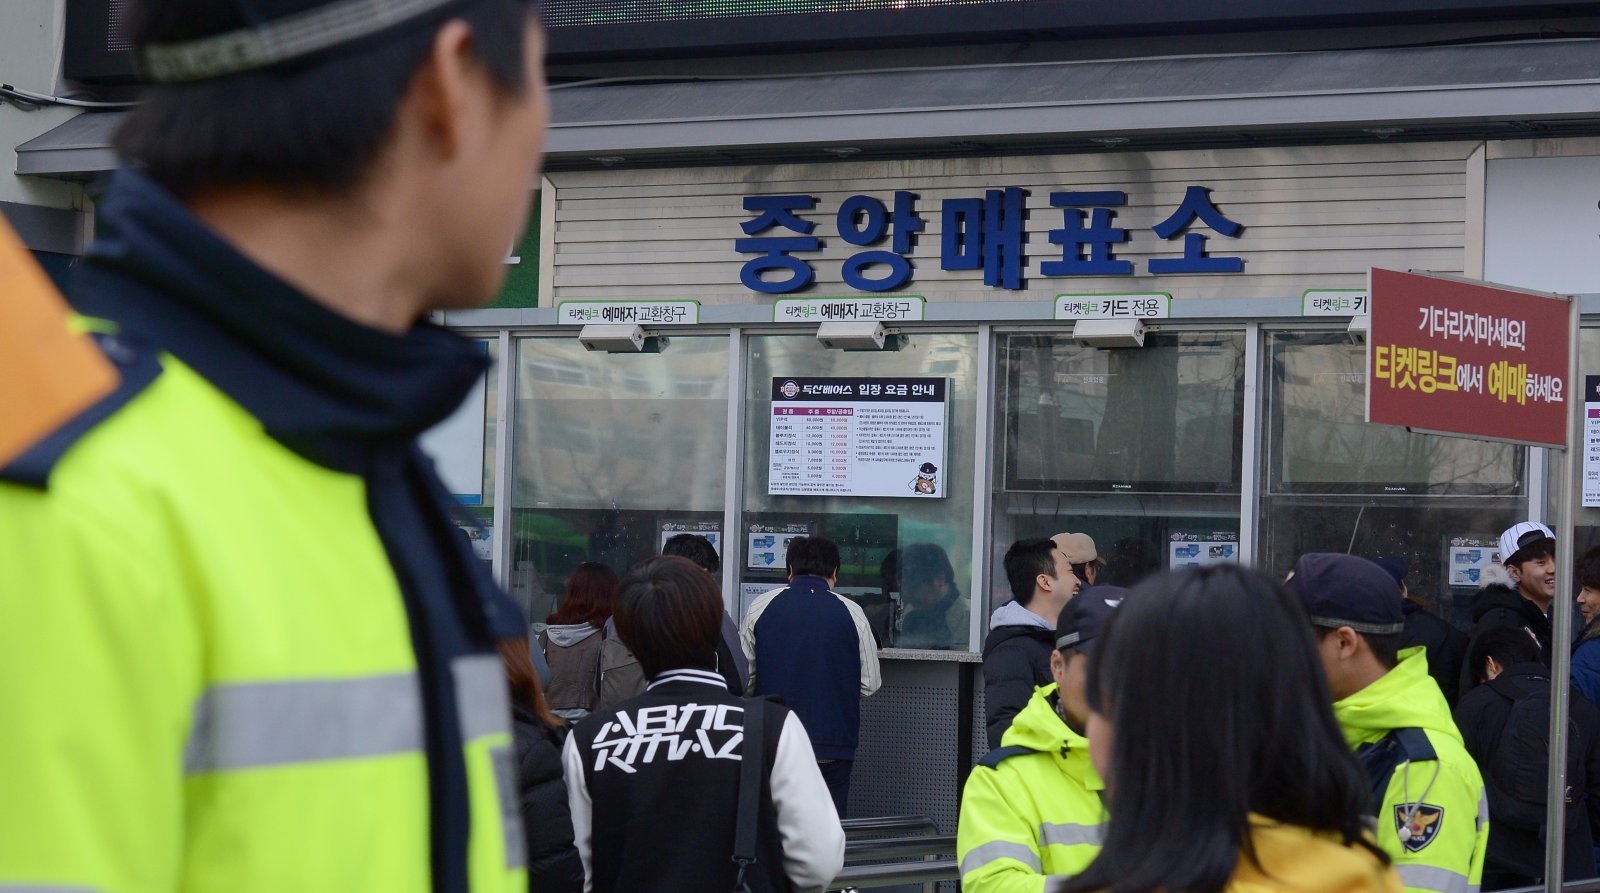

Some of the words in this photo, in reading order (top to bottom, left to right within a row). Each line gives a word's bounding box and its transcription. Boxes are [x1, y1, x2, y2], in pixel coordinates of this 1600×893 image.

[735, 186, 1243, 293] 중앙매표소
[569, 308, 600, 320] 티켓링크
[602, 305, 639, 323] 예매자
[639, 306, 687, 323] 교환창구
[785, 305, 818, 318] 티켓링크
[821, 303, 859, 321] 예매자
[859, 302, 912, 320] 교환창구
[1064, 302, 1099, 314] 티켓링크
[1102, 299, 1130, 317] 카드
[1131, 299, 1160, 317] 전용
[1312, 299, 1350, 311] 티켓링크
[1418, 305, 1526, 351] 기다리지마세요!
[1375, 344, 1484, 395] 티켓링크에서
[1487, 360, 1564, 406] 예매하세요
[858, 384, 881, 396] 입장
[885, 384, 908, 396] 요금
[912, 384, 935, 396] 안내
